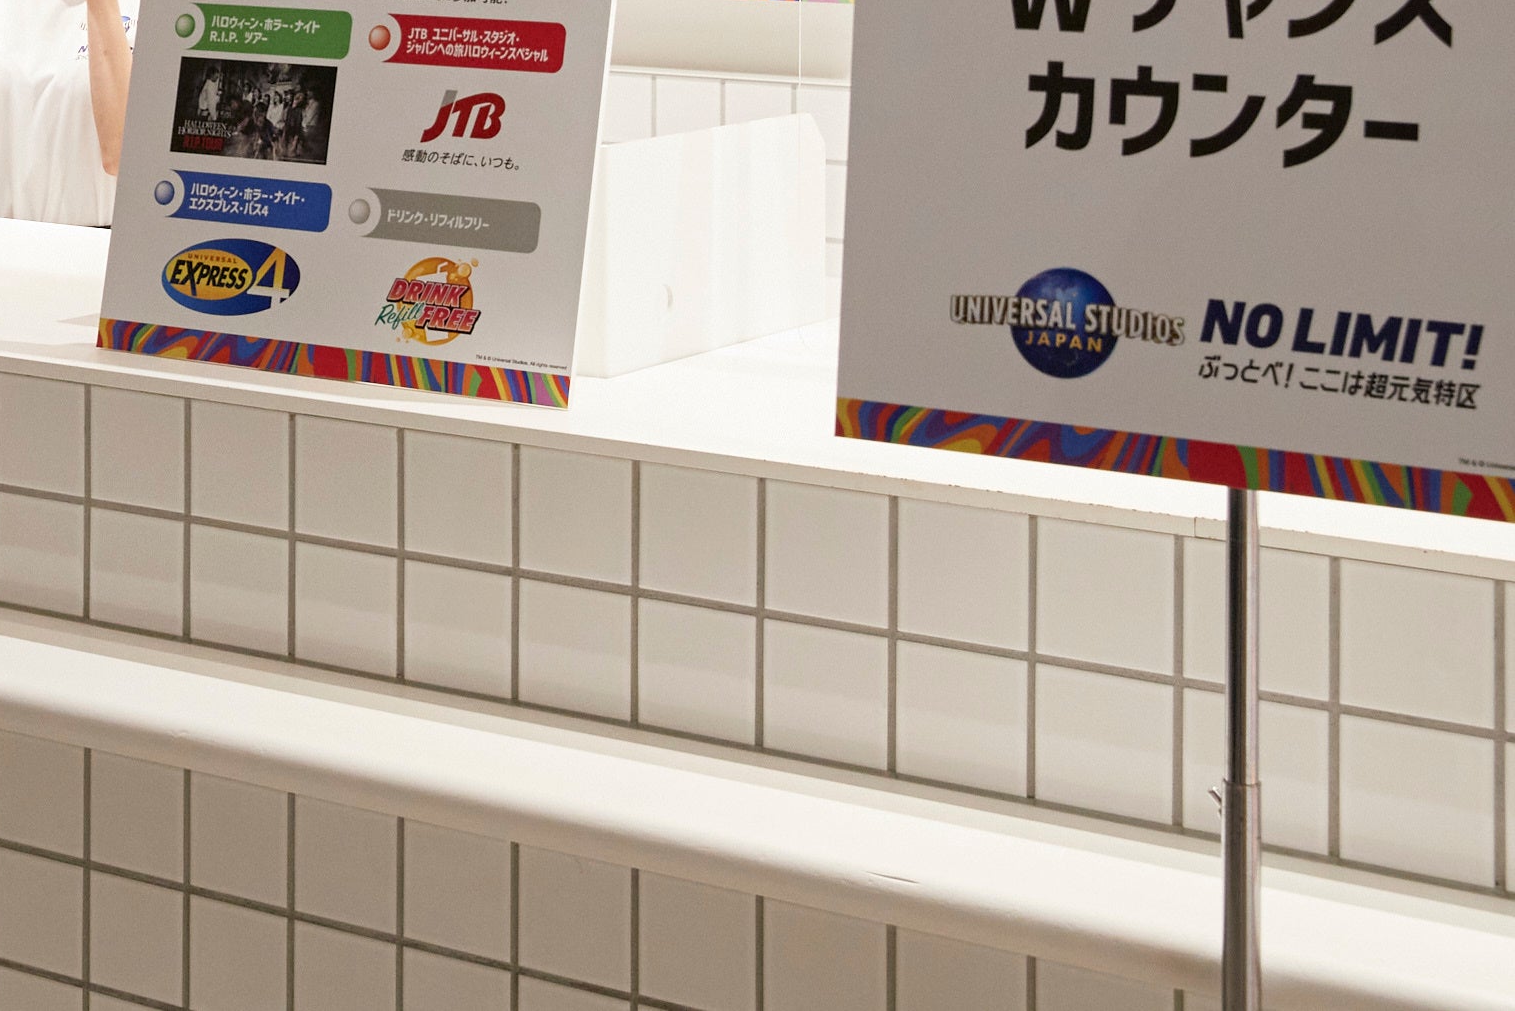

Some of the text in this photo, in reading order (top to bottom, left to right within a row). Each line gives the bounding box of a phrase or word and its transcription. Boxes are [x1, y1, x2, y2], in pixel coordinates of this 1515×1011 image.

[209, 31, 268, 44] R.I.P. ツアー
[408, 27, 428, 40] JTB
[406, 39, 549, 63] ジャパンへの旅ハロウィーンスペシャル
[420, 90, 506, 143] JTB
[1024, 60, 1421, 170] カウンター
[401, 149, 519, 170] 感動のそばに、いつも。
[387, 209, 490, 230] ドリンク・リフィルフリー
[187, 252, 238, 264] UNIVERSAL
[170, 247, 291, 309] EXPRESS 4
[387, 278, 470, 308] DRINK
[374, 302, 482, 335] Refill FREE
[950, 294, 1185, 346] UNIVERSAL STUDIOS
[1025, 331, 1103, 353] JAPAN
[1200, 298, 1485, 371] NO LIMIT!
[1299, 366, 1481, 410] ここは超元気特区
